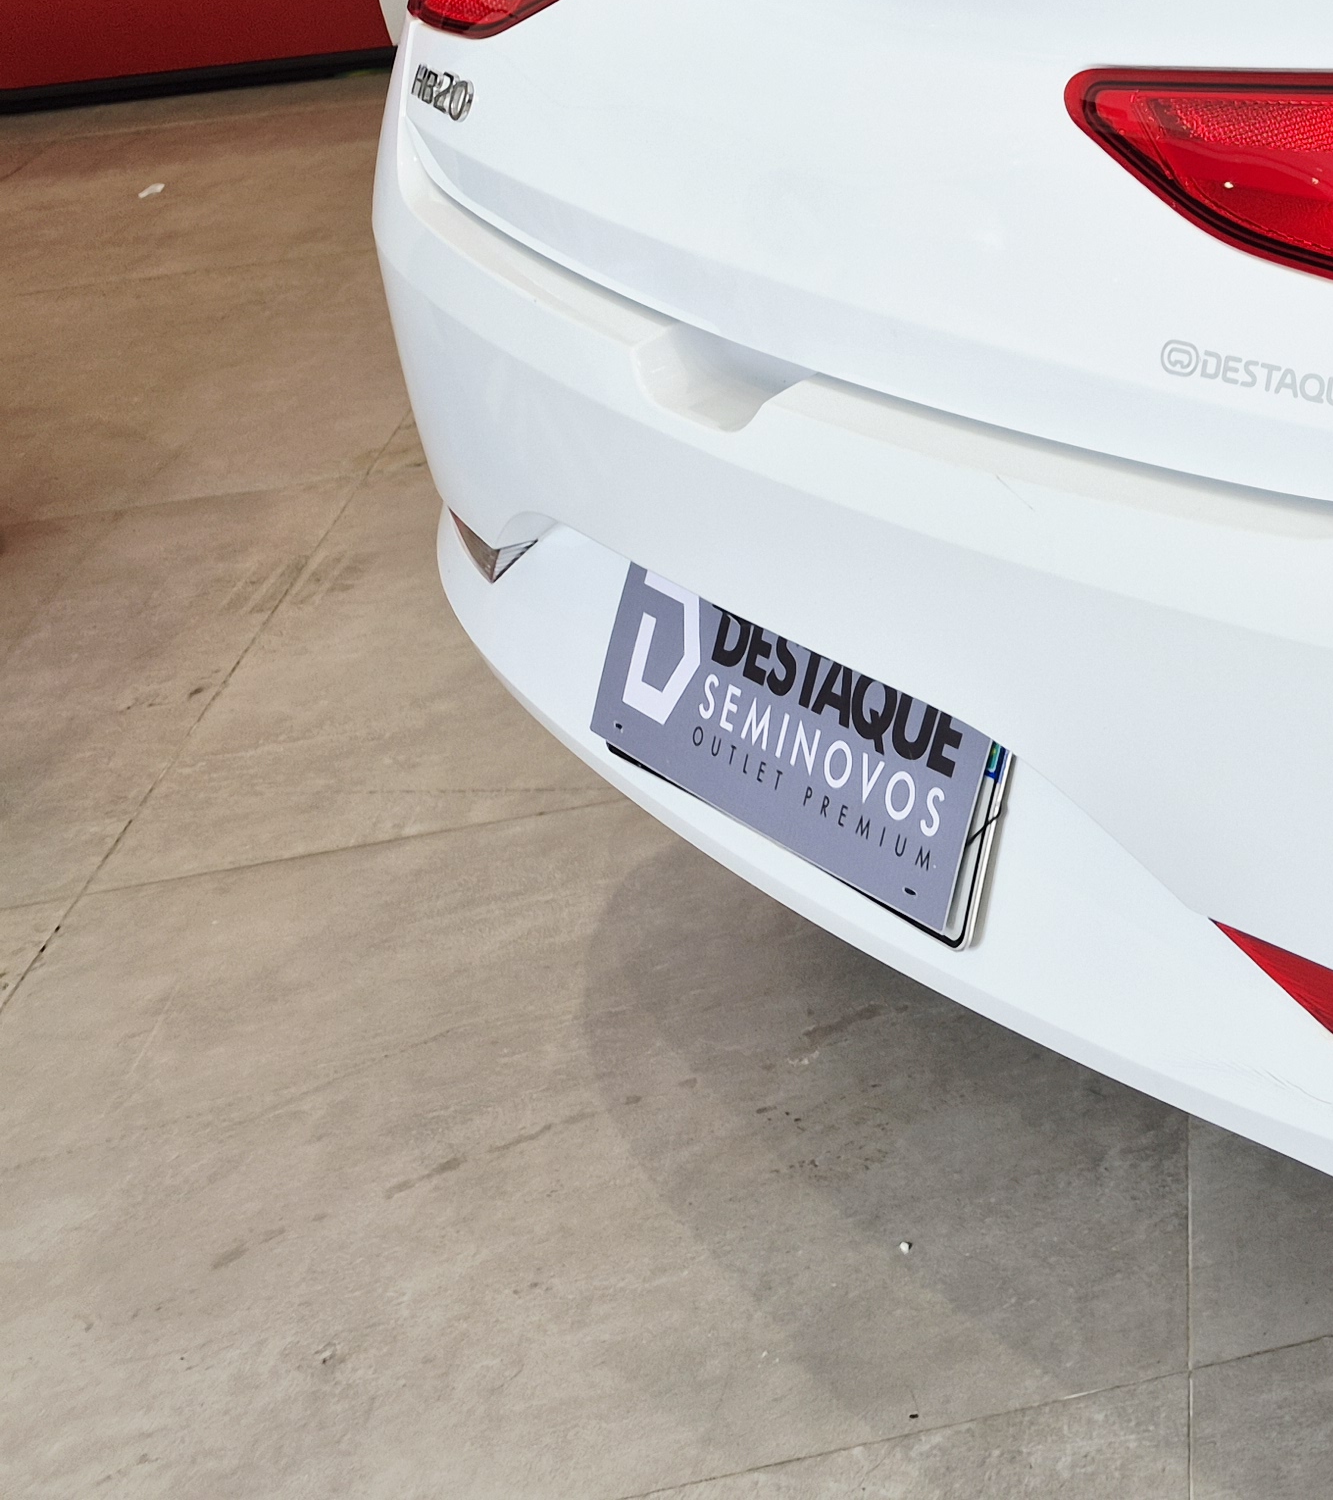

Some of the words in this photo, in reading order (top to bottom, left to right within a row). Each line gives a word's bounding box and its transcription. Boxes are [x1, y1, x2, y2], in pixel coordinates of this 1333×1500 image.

[411, 63, 475, 123] HB20
[698, 673, 946, 837] SEMINOVOS
[711, 602, 964, 779] DESTAQUE
[692, 725, 783, 792] OUTLET
[803, 785, 931, 871] PREMIUM
